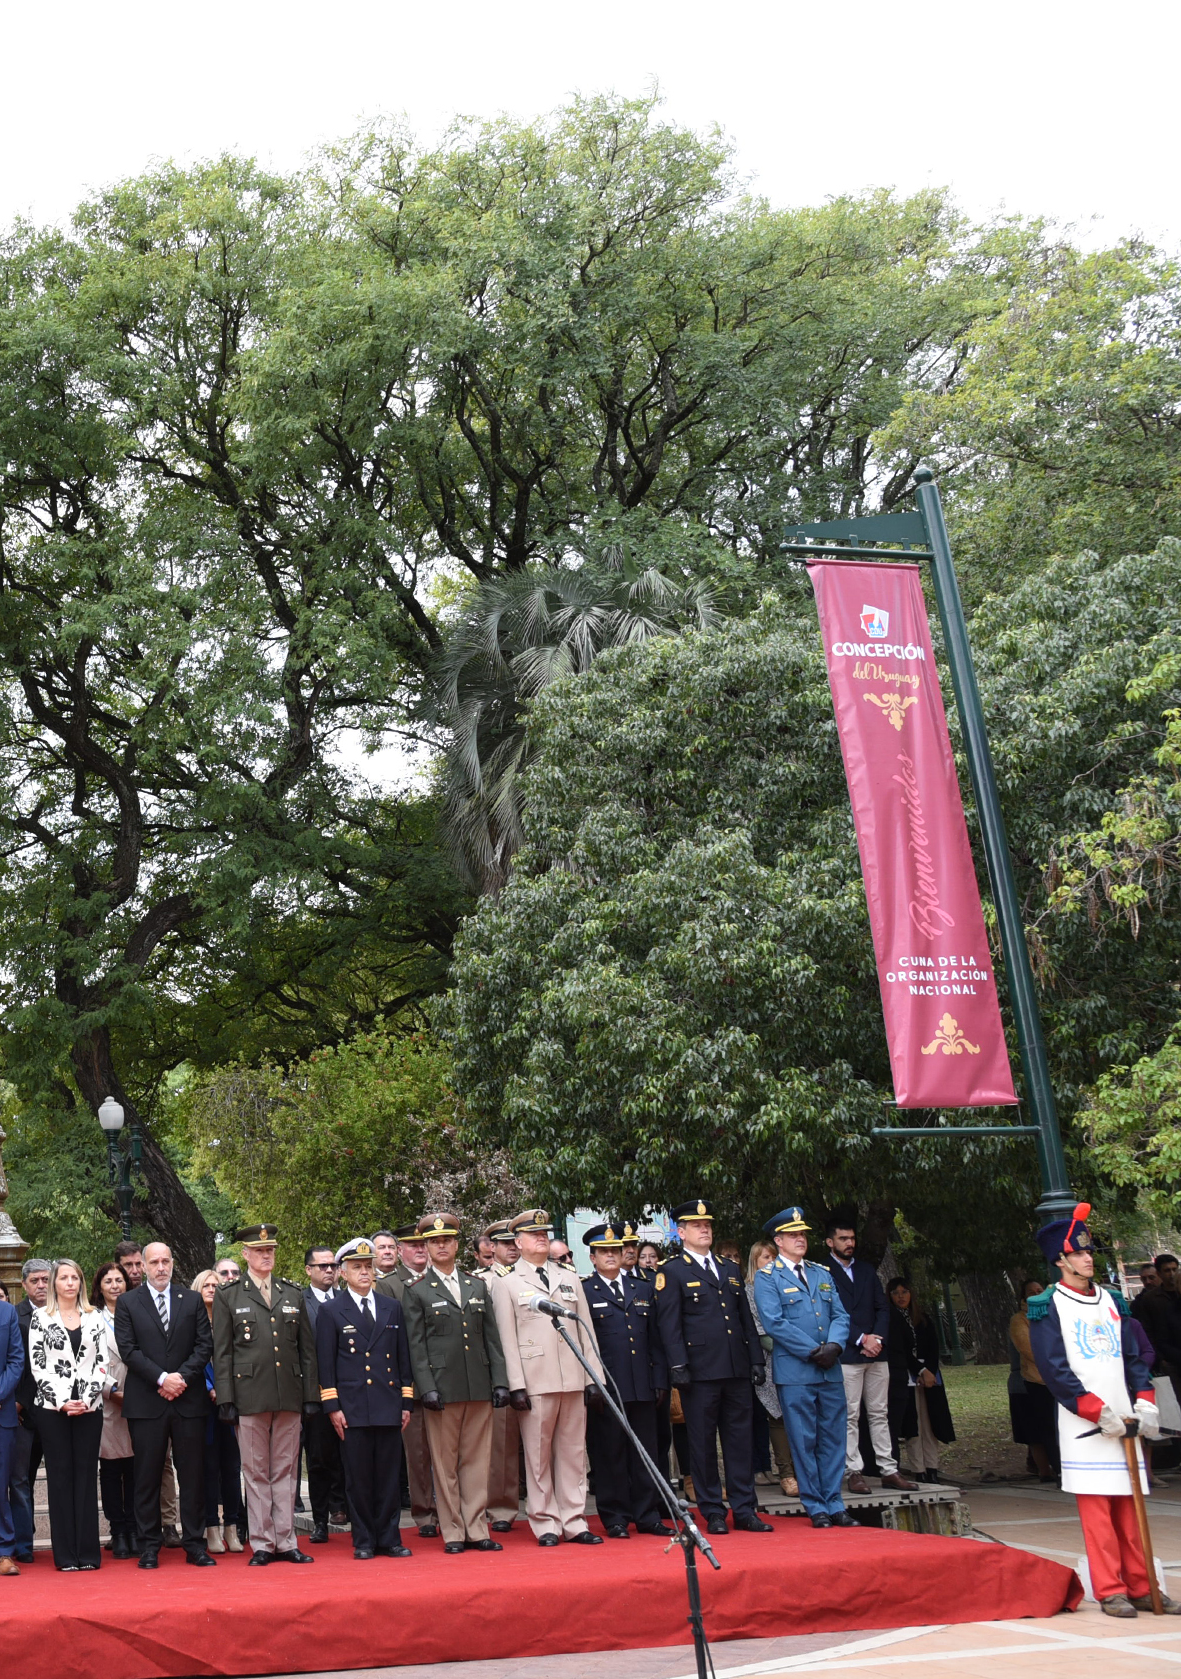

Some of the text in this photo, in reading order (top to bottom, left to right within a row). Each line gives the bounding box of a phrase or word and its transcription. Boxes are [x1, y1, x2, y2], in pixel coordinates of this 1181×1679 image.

[832, 642, 925, 661] CONCEPCIÓN
[853, 662, 920, 689] del Uruguay
[893, 748, 955, 940] Bienvenidos
[899, 956, 976, 967] CUNA DE LA
[886, 969, 987, 982] ORGANIZACIÓN
[909, 985, 976, 995] NACIONAL
